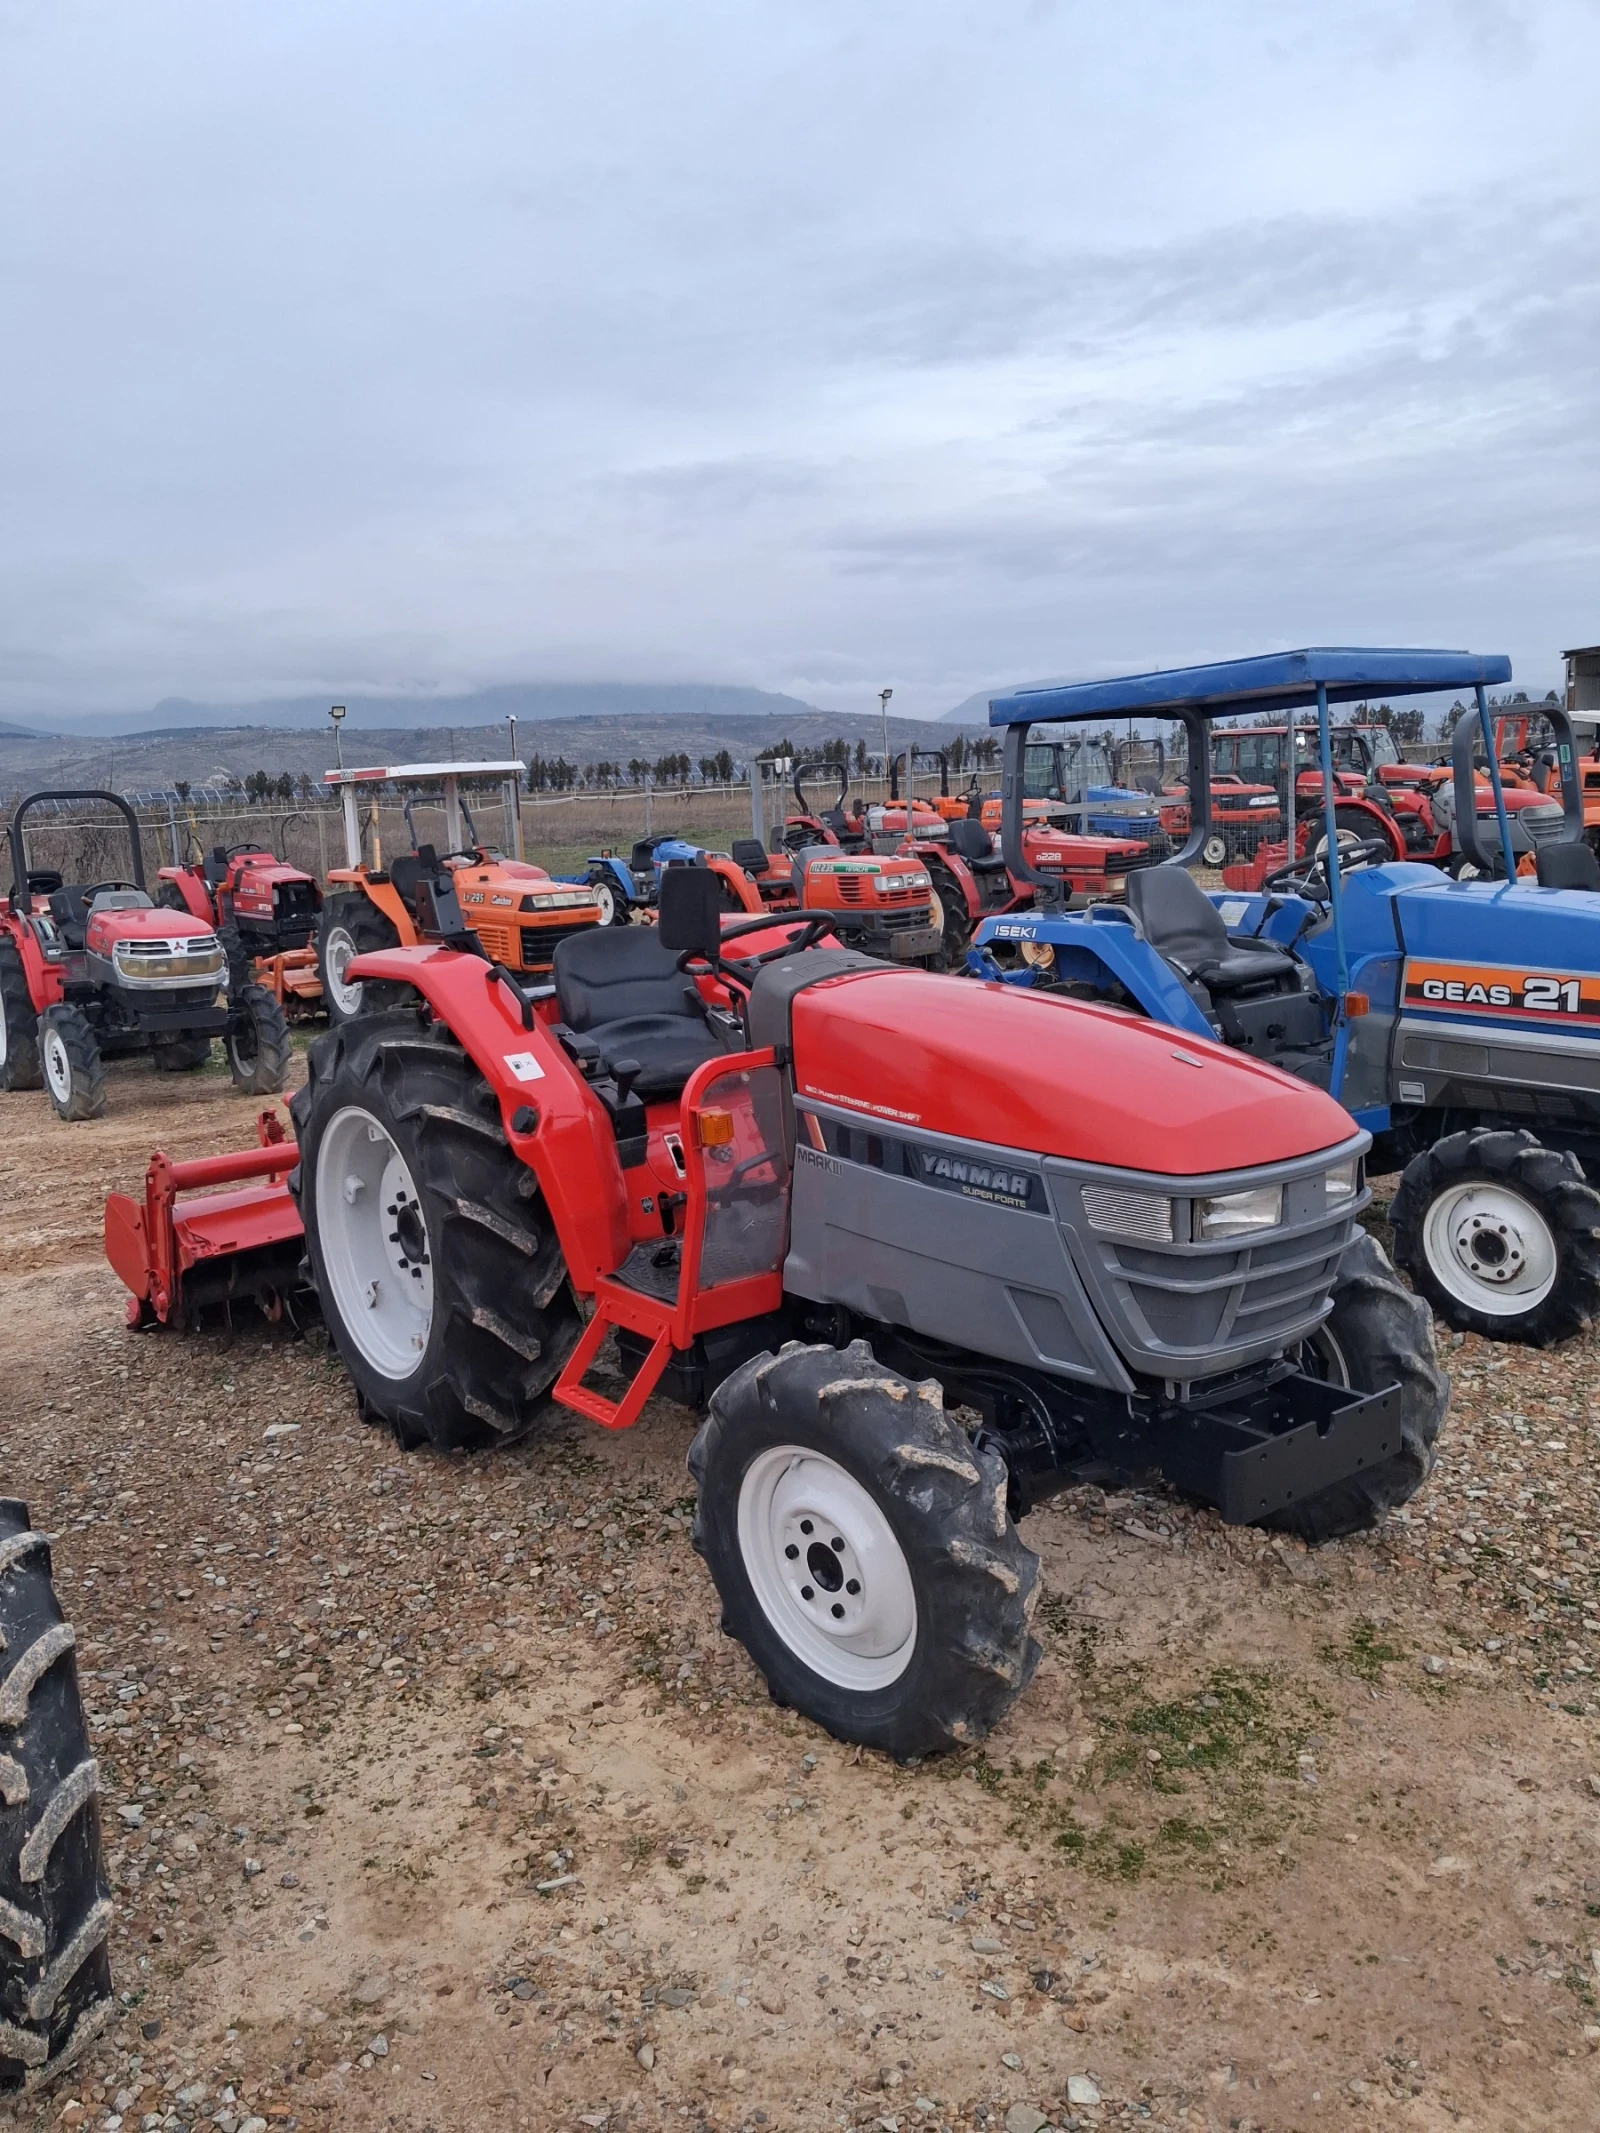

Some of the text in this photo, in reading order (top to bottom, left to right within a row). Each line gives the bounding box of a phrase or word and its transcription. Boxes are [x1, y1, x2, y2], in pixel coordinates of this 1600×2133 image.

[994, 924, 1037, 939] ISEKI
[1422, 976, 1581, 1013] GEAS 21
[921, 1152, 1030, 1198] YANMAR
[962, 1185, 1027, 1208] SUPER FORTE
